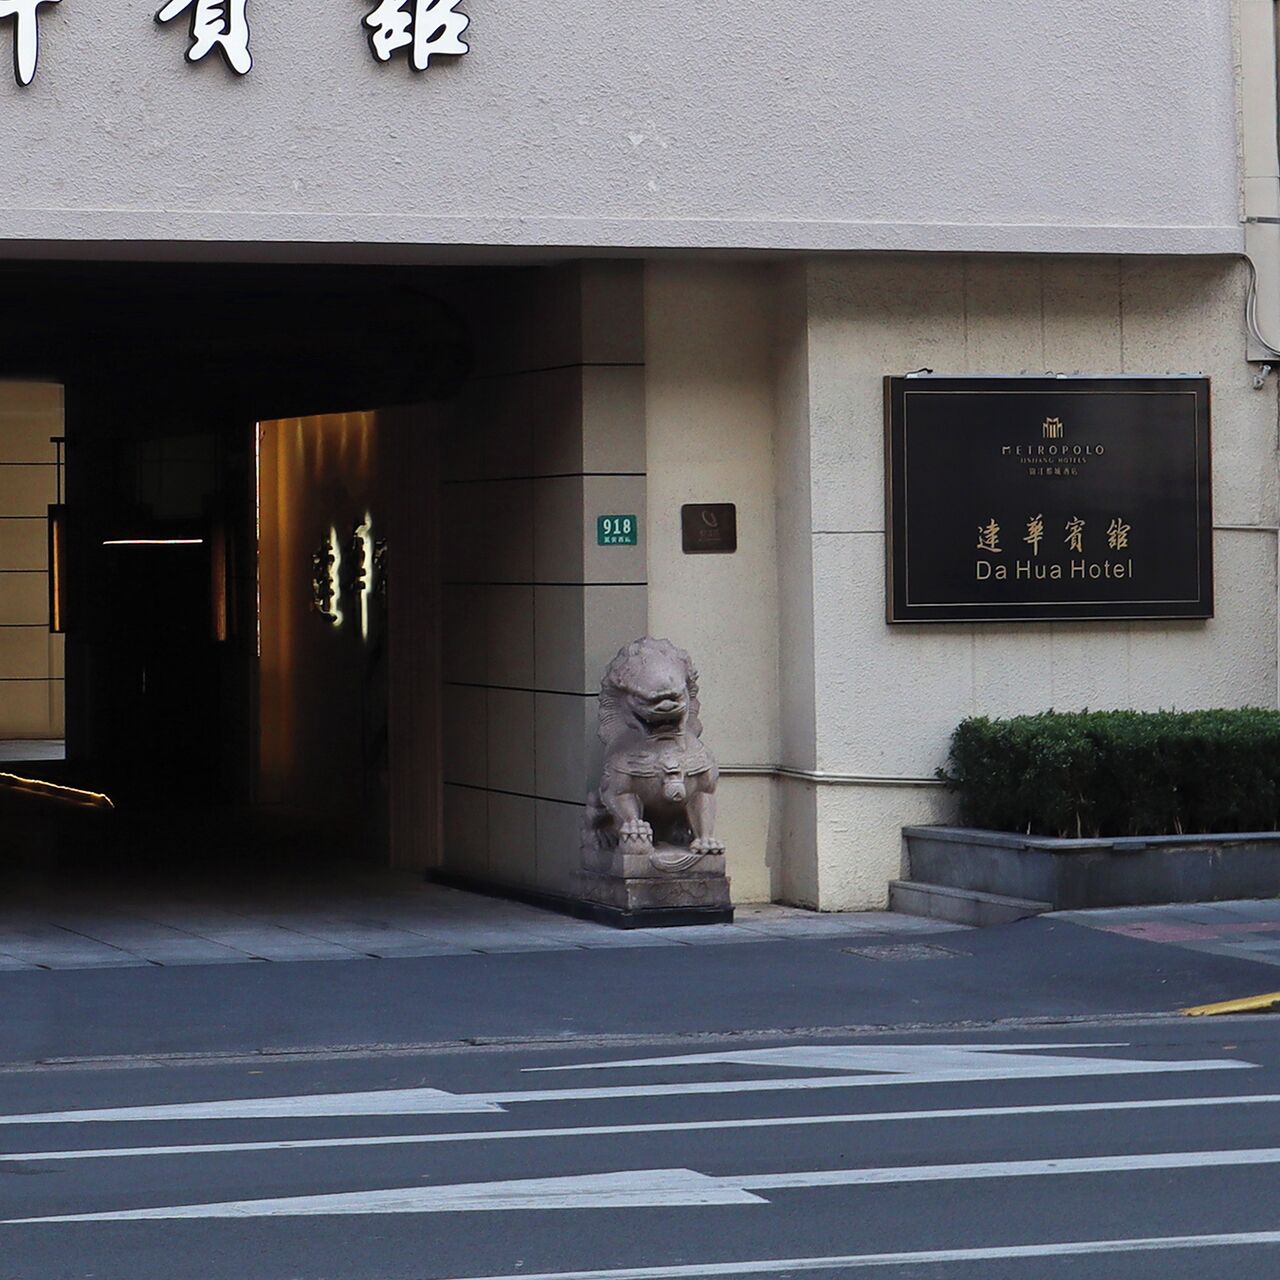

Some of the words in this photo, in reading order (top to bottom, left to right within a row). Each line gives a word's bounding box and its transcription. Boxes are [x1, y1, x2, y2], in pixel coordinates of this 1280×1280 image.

[603, 518, 631, 535] 918
[976, 560, 1007, 580] Da
[1016, 560, 1062, 580] Hua
[1071, 559, 1133, 579] Hotel
